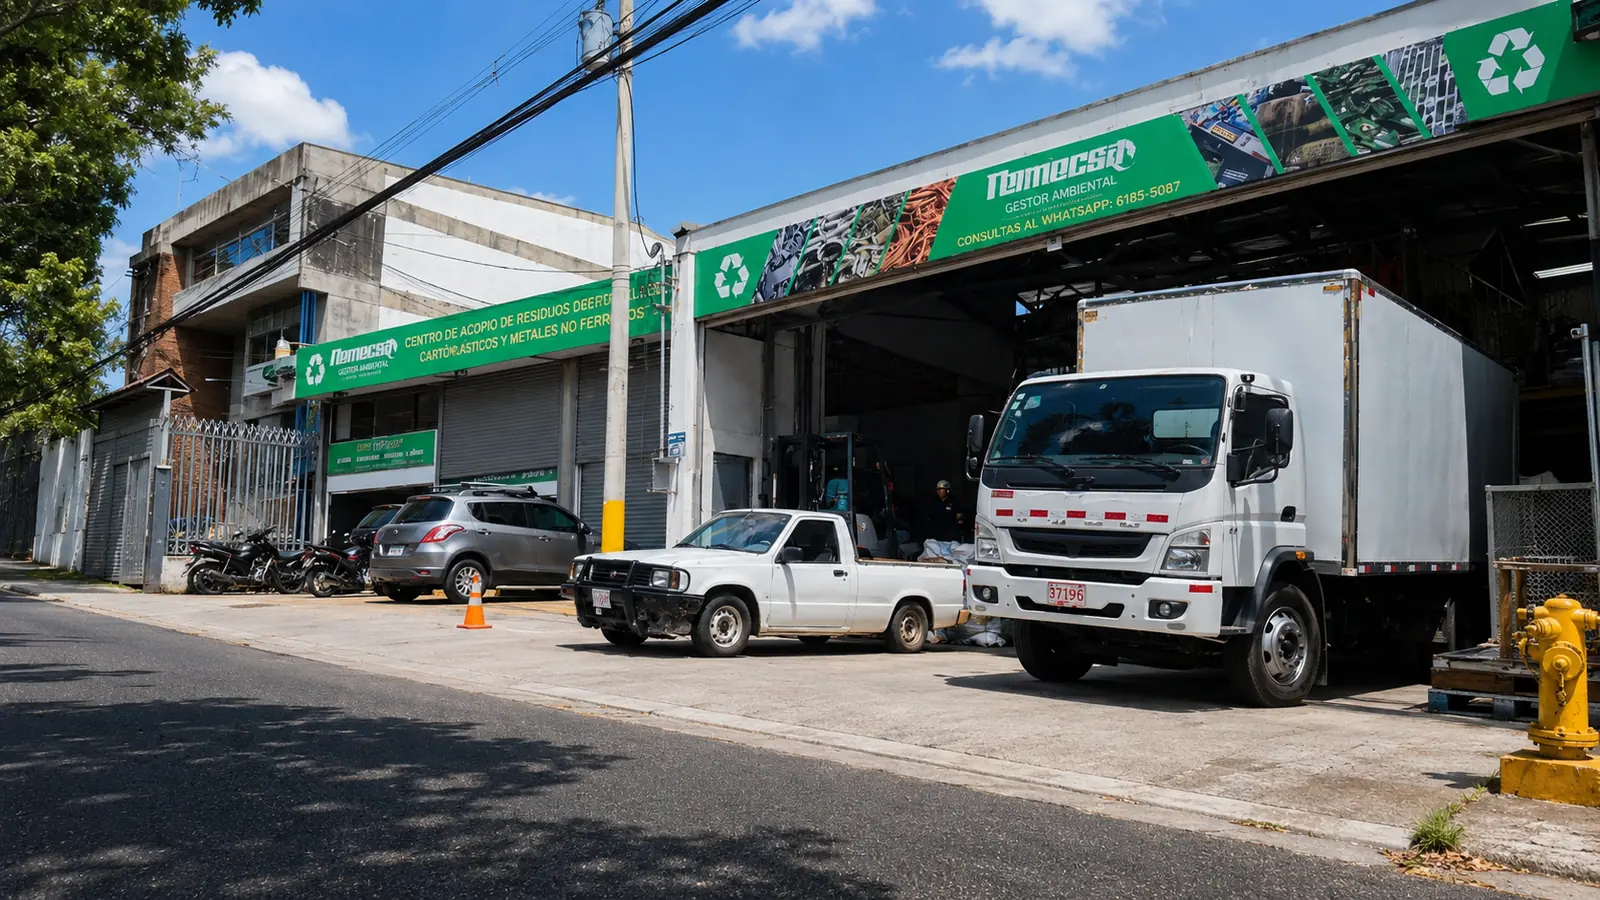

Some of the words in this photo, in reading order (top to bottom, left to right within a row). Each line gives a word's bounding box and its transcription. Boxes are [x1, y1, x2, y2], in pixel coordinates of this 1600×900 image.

[957, 222, 1021, 248] CONSULTAS
[1023, 218, 1038, 231] AL
[1042, 199, 1113, 226] WHATSAPP:
[1115, 180, 1181, 207] 6185-5087
[1005, 193, 1049, 214] GESTOR
[1050, 176, 1117, 202] AMBIENTAL
[404, 331, 443, 348] CENTRO
[444, 327, 458, 341] DE
[460, 318, 498, 336] ACOPIO
[500, 315, 514, 329] DE
[517, 302, 570, 324] RESIDUOS
[500, 334, 508, 346] Y
[509, 324, 558, 344] METALES
[561, 320, 577, 334] NO
[1049, 587, 1084, 602] 37196
